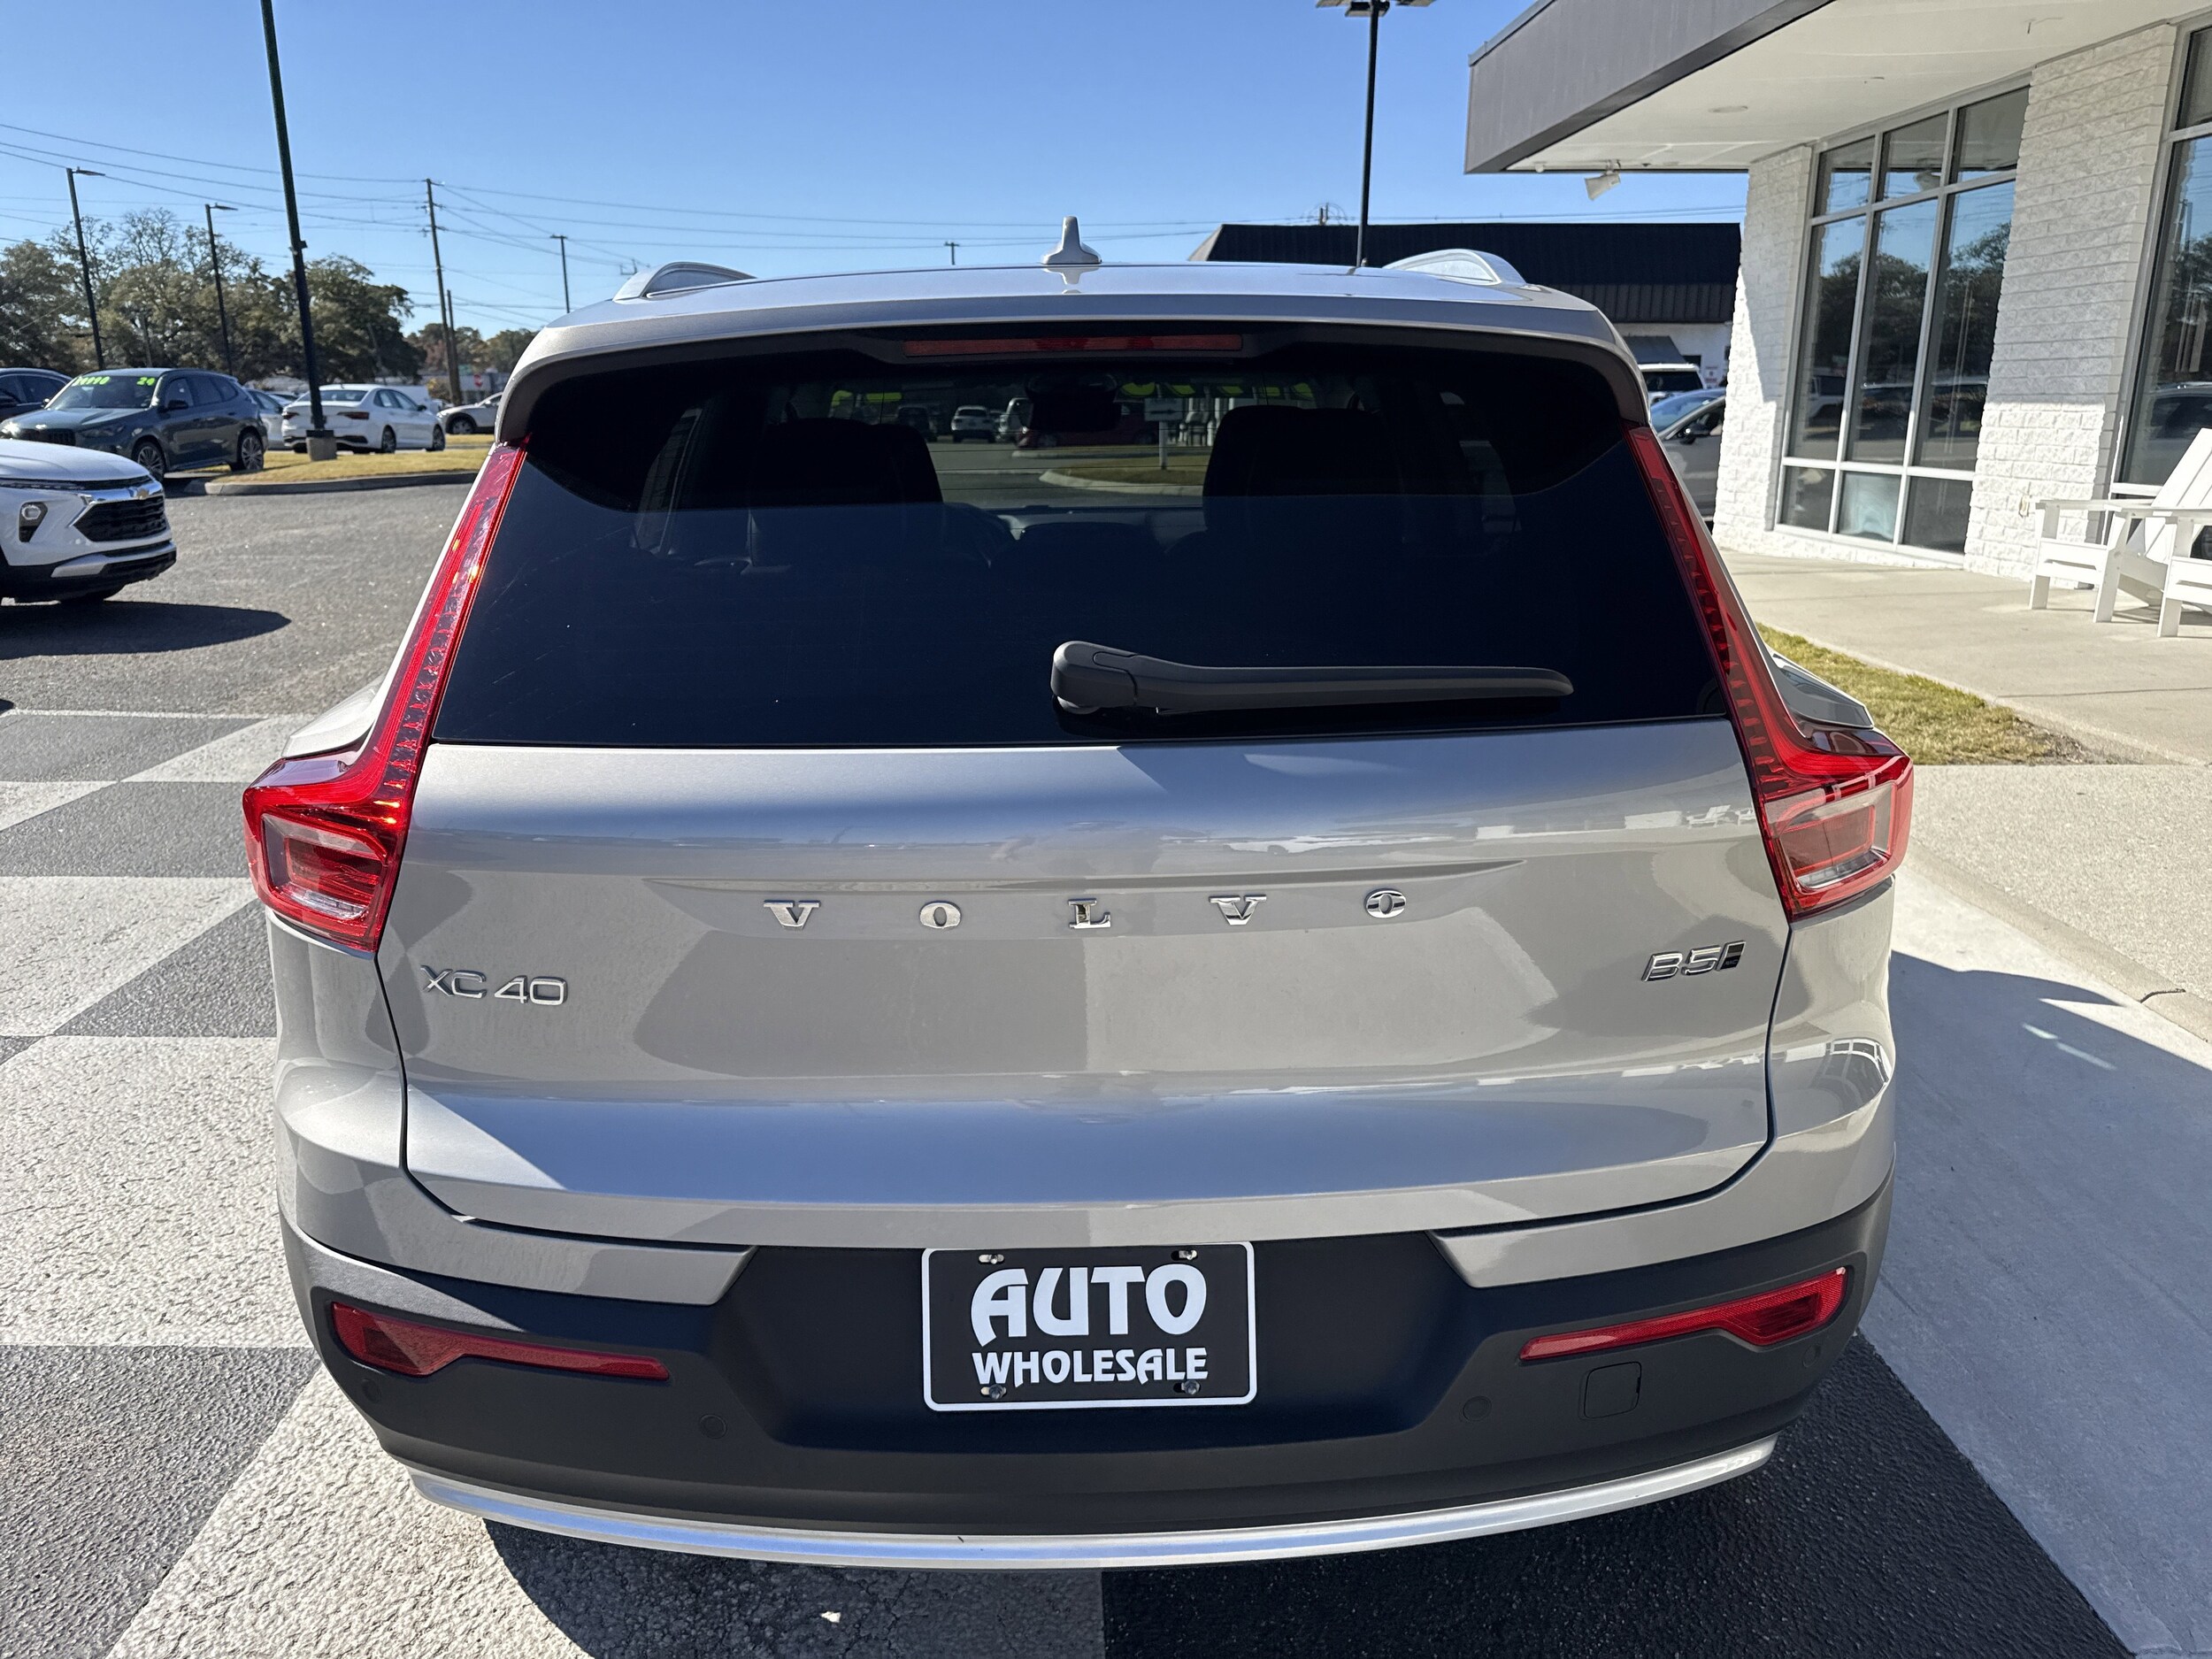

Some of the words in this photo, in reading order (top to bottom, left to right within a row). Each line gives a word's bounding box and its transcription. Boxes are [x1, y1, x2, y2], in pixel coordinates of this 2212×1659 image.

[763, 888, 1407, 930] VOLVO
[1641, 945, 1721, 981] B5
[971, 1263, 1207, 1347] AUTO
[972, 1348, 1209, 1387] WHOLESALE
